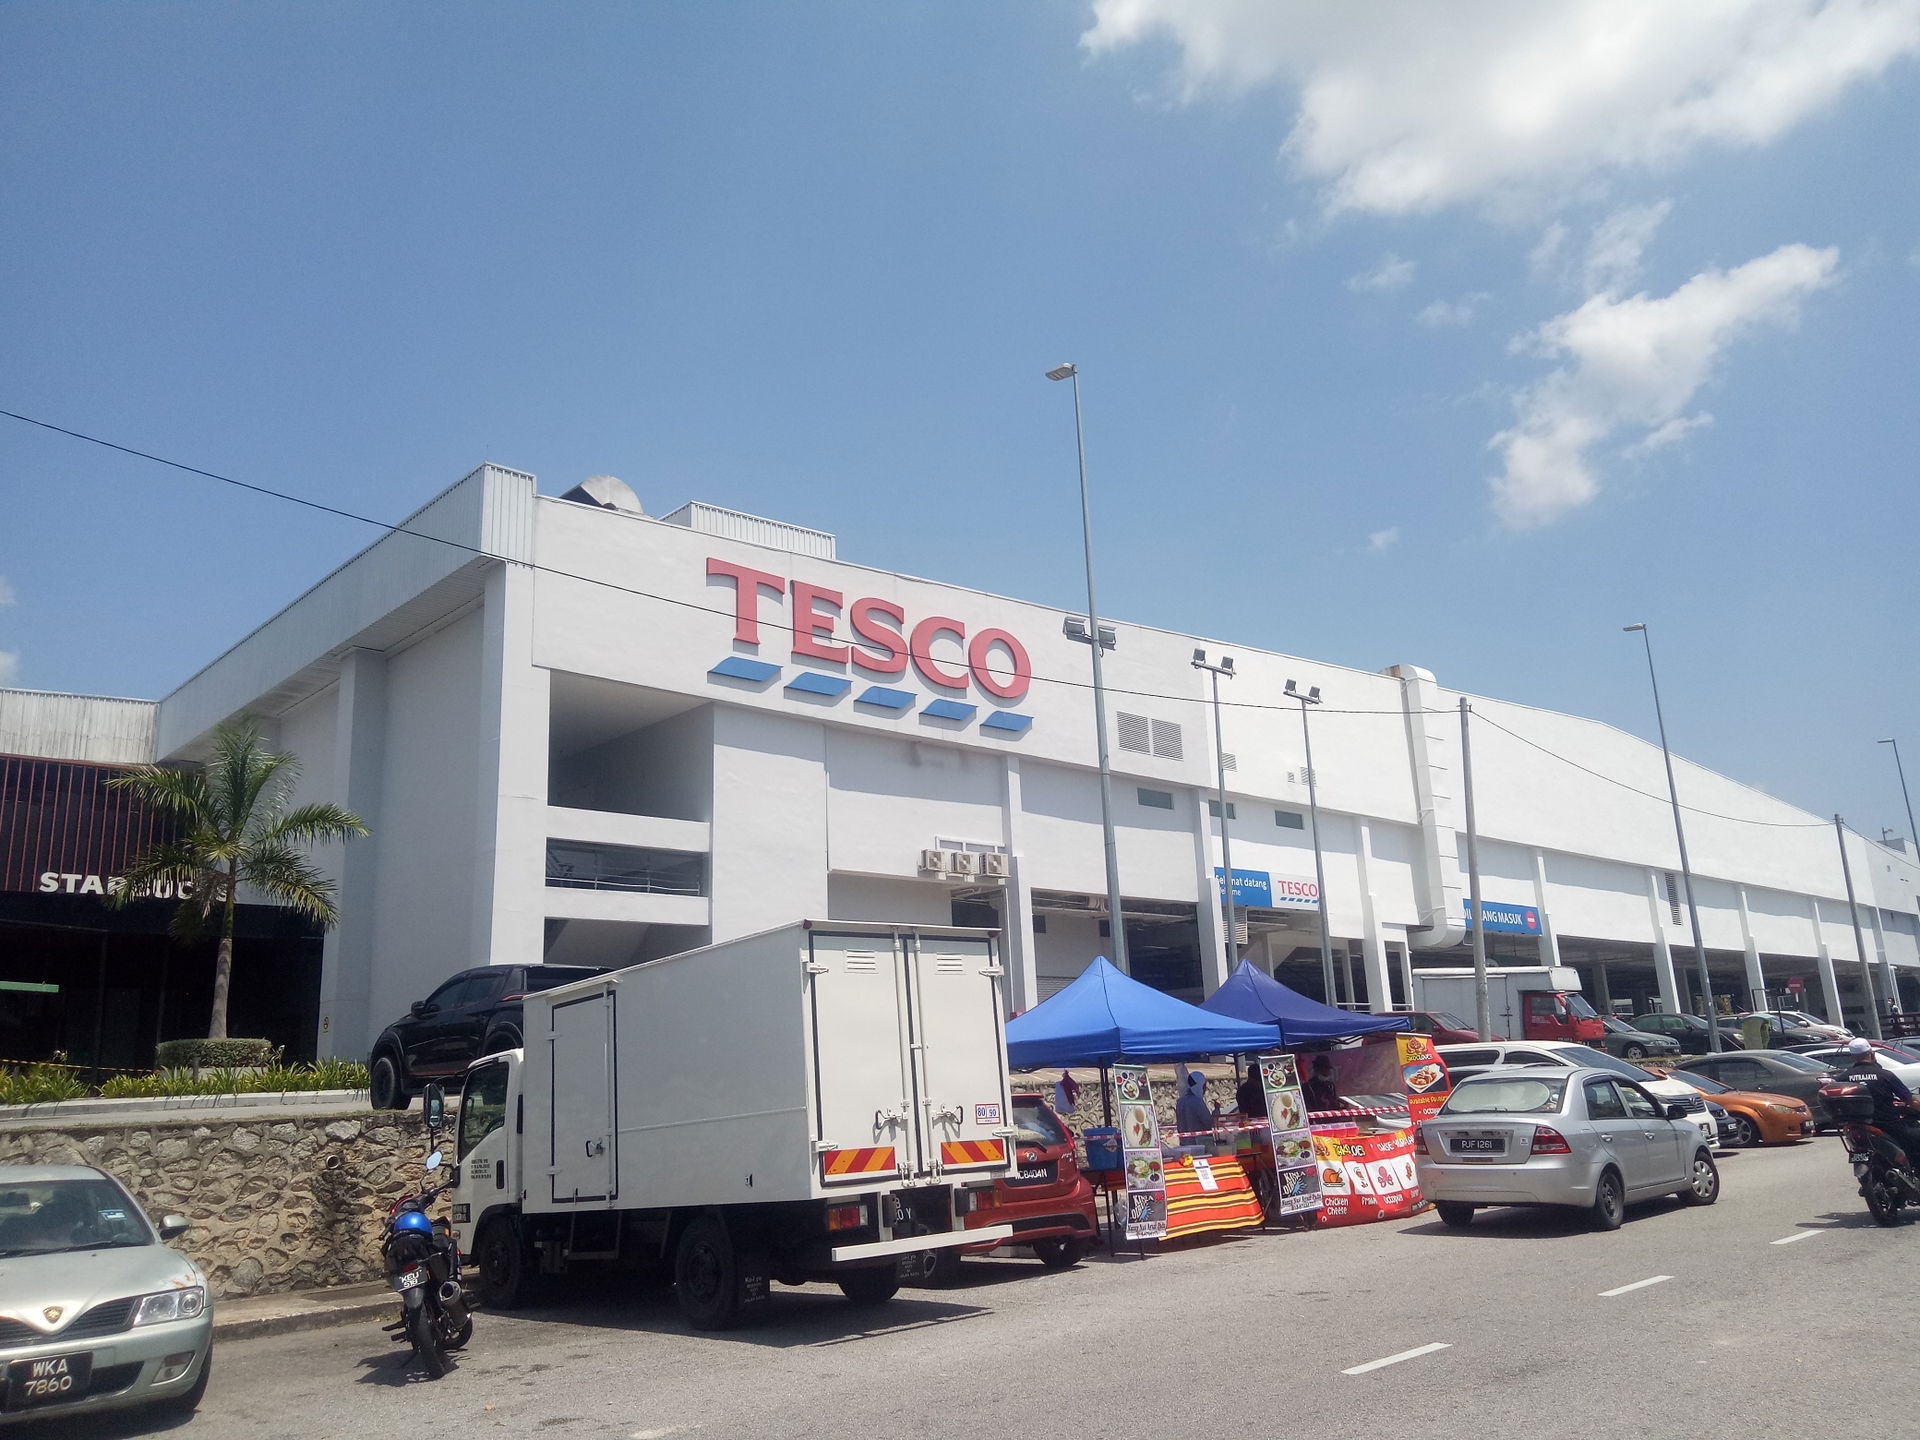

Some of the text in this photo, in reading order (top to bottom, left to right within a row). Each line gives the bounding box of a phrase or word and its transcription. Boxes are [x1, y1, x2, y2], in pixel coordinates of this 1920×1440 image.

[706, 557, 1032, 698] TESCO
[1244, 878, 1267, 891] datang
[1278, 880, 1319, 897] TESCO
[1498, 911, 1523, 926] MASUK
[1324, 1197, 1349, 1207] Chicken
[1327, 1206, 1348, 1216] Cheese
[33, 1358, 68, 1378] WKA
[24, 1375, 73, 1396] 7860
